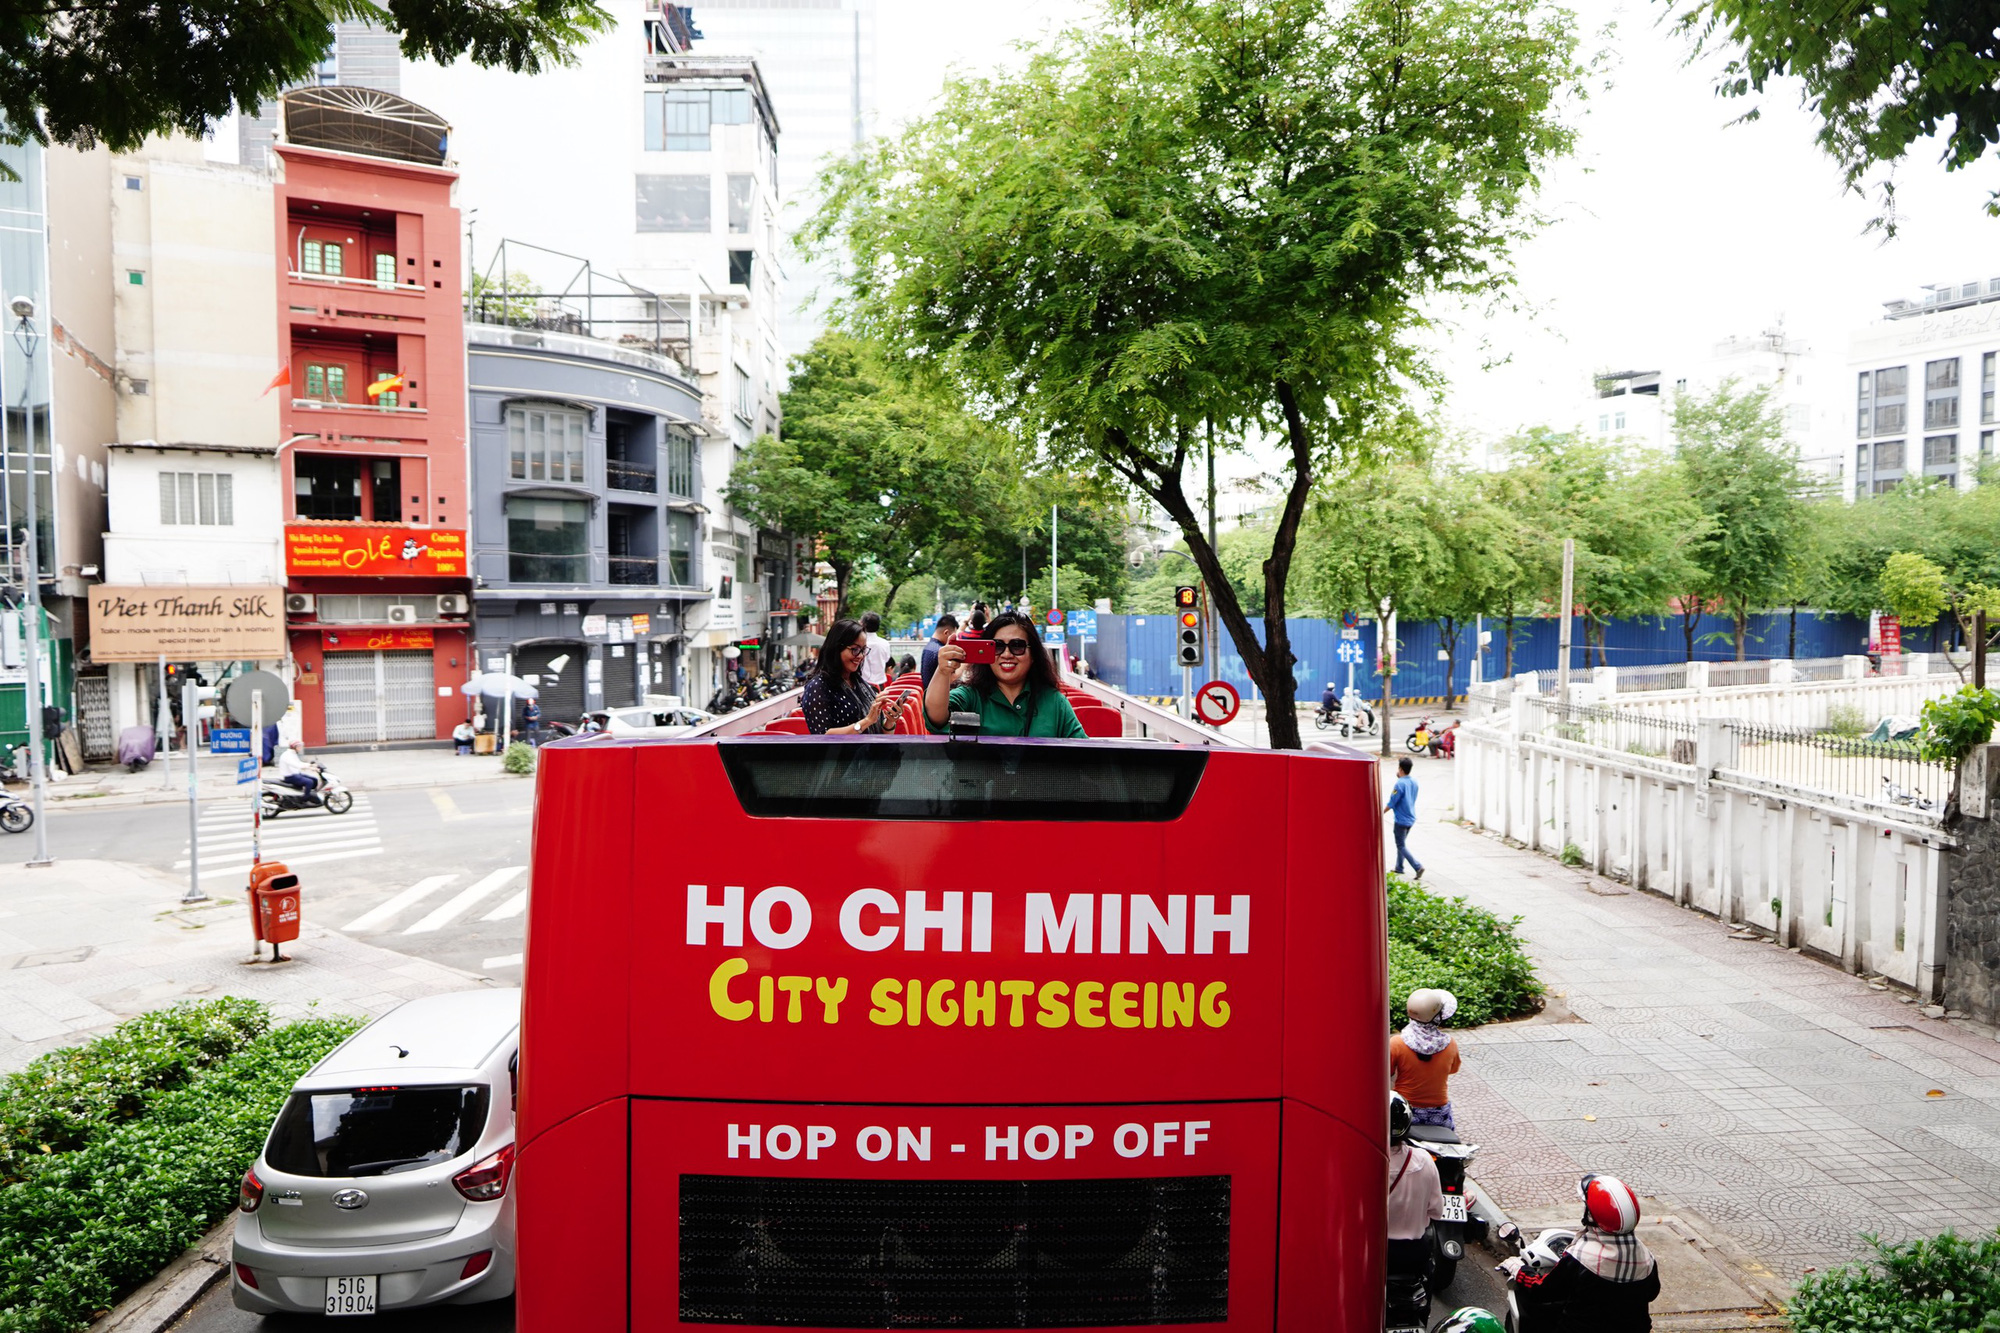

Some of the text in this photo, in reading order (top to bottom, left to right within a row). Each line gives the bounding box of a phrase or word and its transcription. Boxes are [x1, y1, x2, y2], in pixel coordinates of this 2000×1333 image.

[1920, 304, 2000, 334] PAPAY
[343, 535, 396, 569] Olé
[430, 532, 460, 544] Cocina
[98, 595, 274, 618] Viet Thanh Silk
[687, 885, 1250, 954] HO CHI MINH
[869, 978, 1230, 1028] SIGHTSEEING
[727, 1124, 836, 1160] HOP
[856, 1126, 931, 1161] ON
[985, 1125, 1094, 1161] HOP
[1113, 1120, 1210, 1157] OFF
[337, 1277, 366, 1294] 51G
[326, 1295, 375, 1314] 319.04
